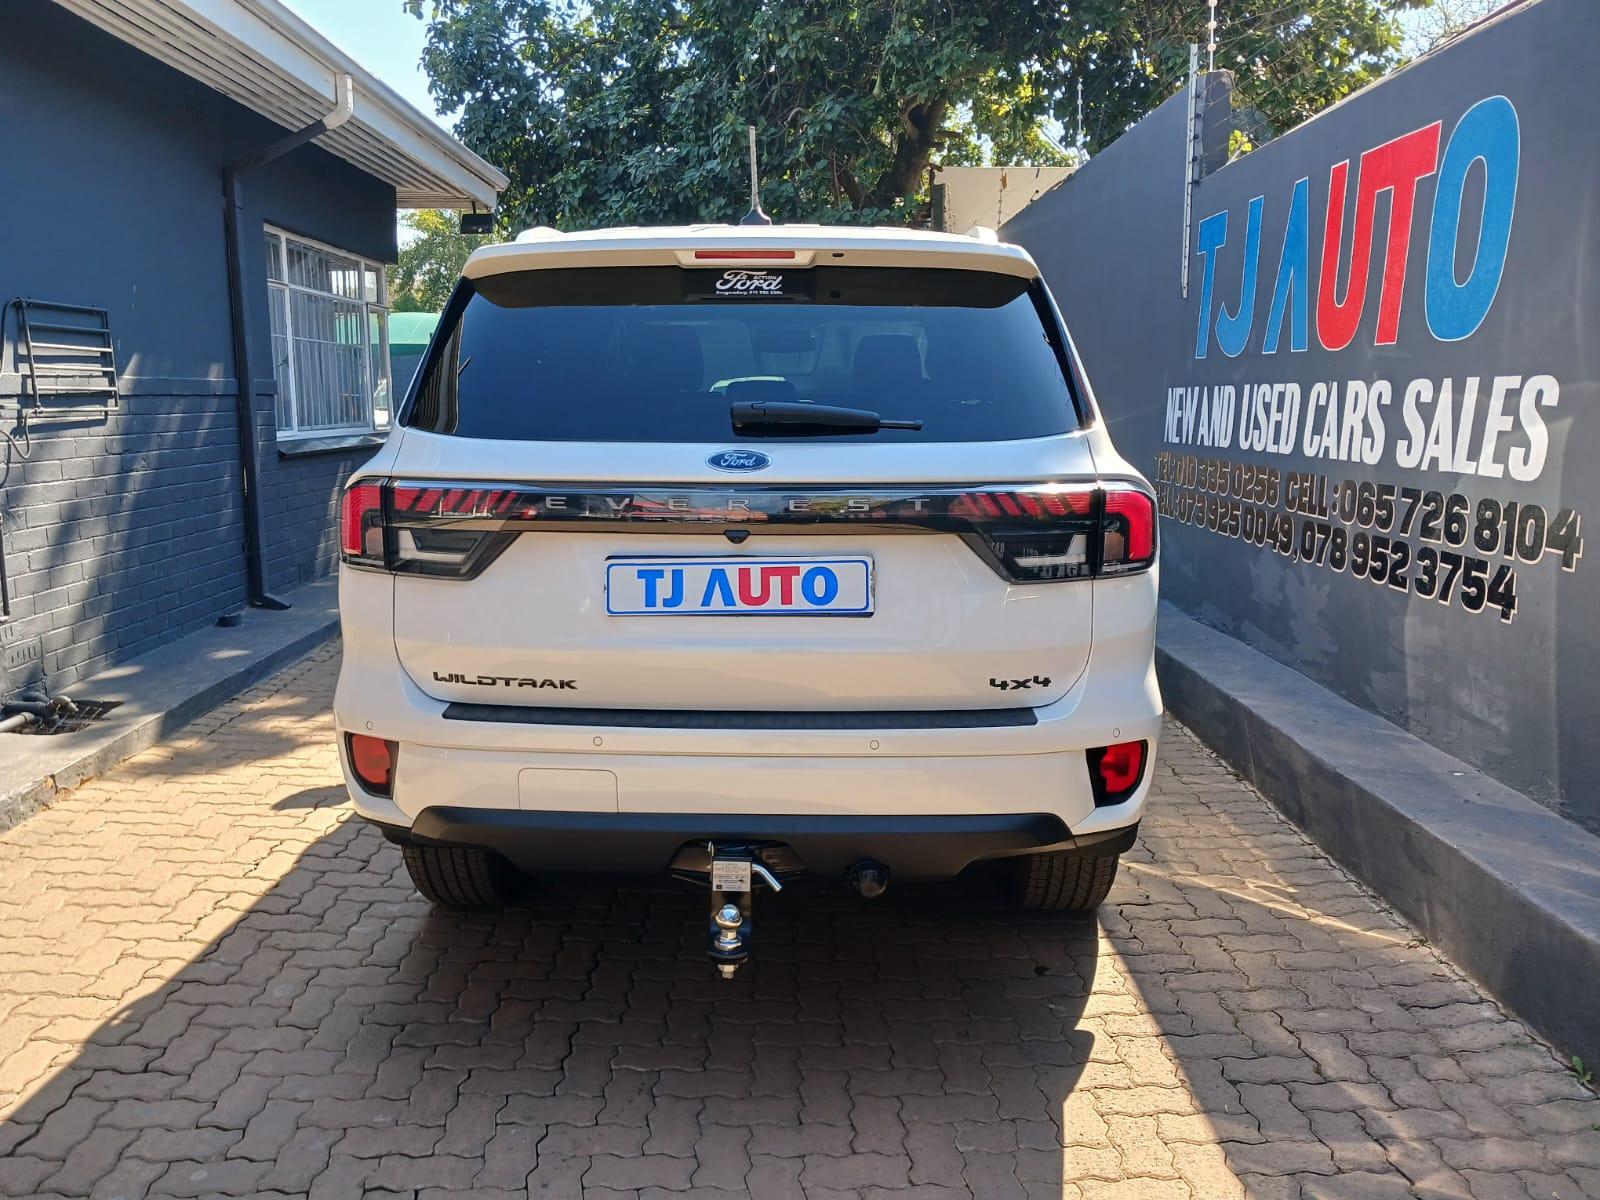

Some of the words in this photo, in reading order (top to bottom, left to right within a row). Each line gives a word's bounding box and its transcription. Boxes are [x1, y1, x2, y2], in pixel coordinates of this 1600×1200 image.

[1195, 194, 1264, 358] TJ
[1262, 95, 1521, 352] AUTO
[715, 270, 782, 290] Ford
[1164, 386, 1199, 444] NEW
[1197, 385, 1236, 448] AND
[1239, 383, 1301, 455] USED
[1303, 380, 1392, 465] CARS
[1396, 375, 1560, 481] SALES
[721, 454, 756, 466] Ford
[545, 496, 931, 511] EVEREST
[1199, 458, 1231, 496] 335
[1232, 463, 1281, 508] 0256
[1399, 487, 1471, 548] 726
[1474, 498, 1584, 573] 8104
[1208, 498, 1242, 539] 925
[1352, 532, 1411, 593] 952
[1415, 546, 1518, 624] 3754
[637, 568, 684, 608] TJ
[700, 566, 839, 608] AUTO
[433, 671, 578, 690] WILDTRAK
